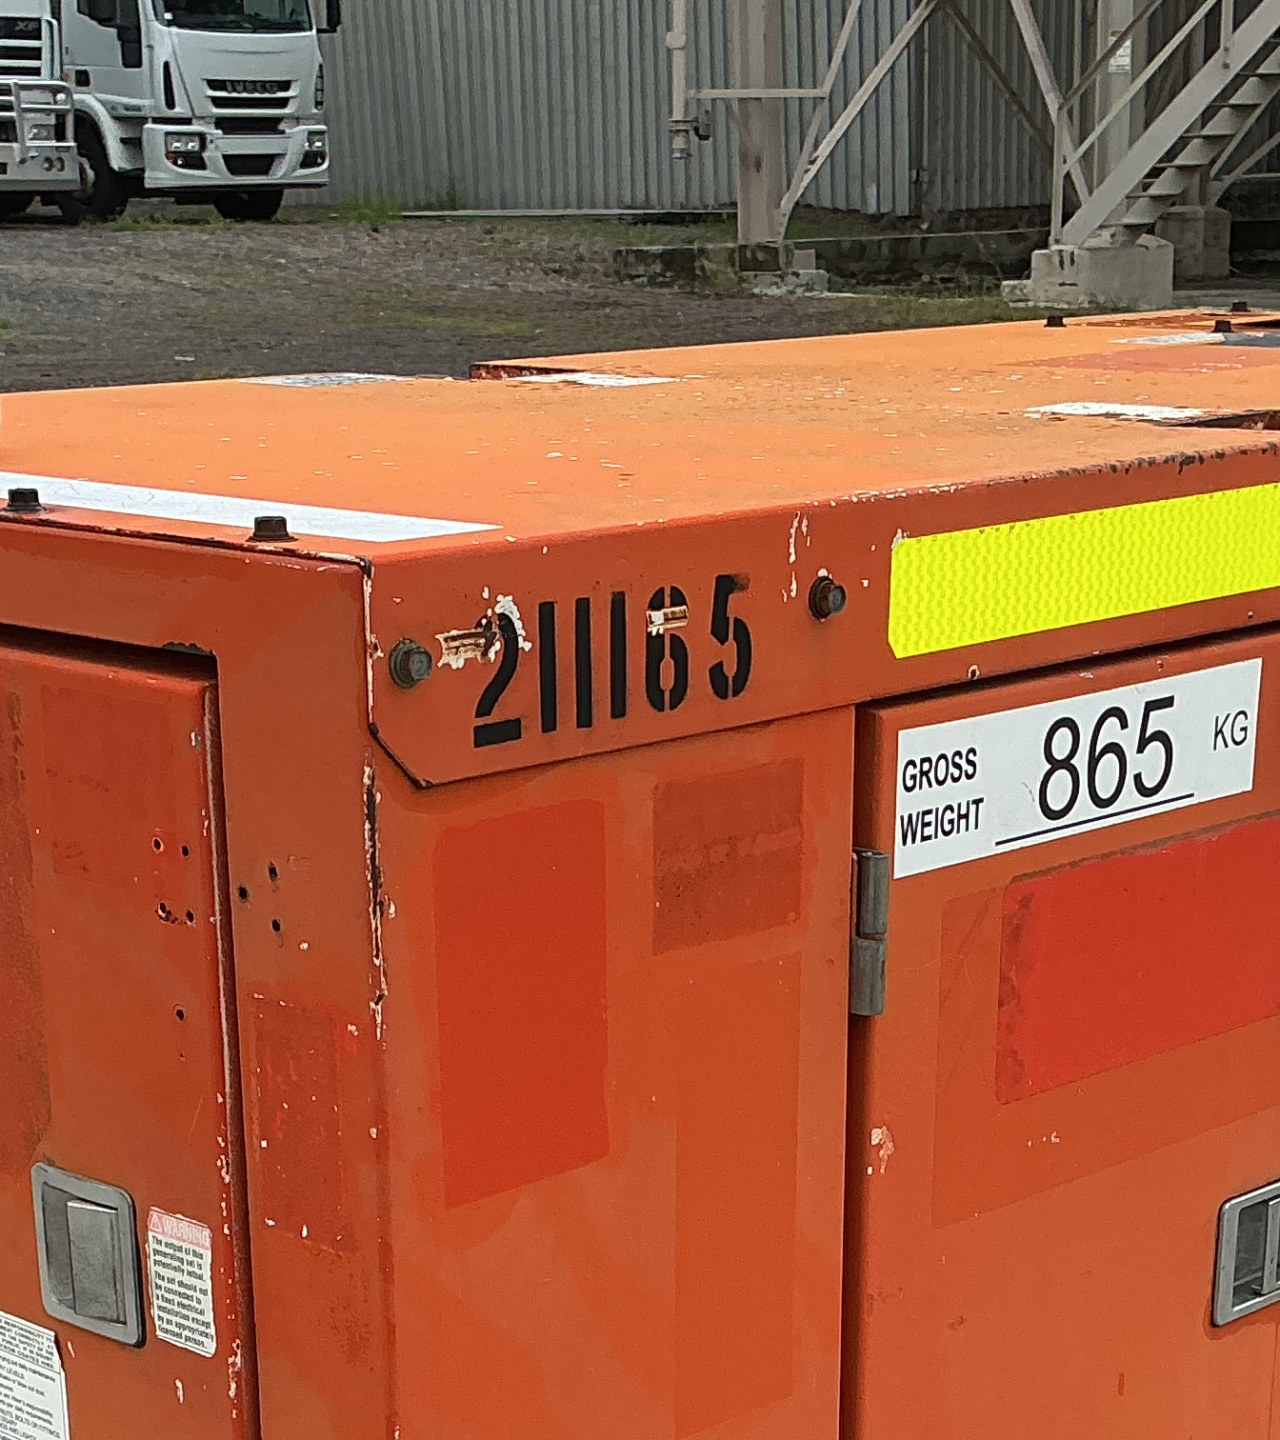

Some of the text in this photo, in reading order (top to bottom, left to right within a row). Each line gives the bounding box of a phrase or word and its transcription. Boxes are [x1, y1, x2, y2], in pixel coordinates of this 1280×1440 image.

[225, 80, 278, 94] IVECO
[472, 573, 752, 748] 211165
[902, 746, 978, 793] GROSS
[1038, 695, 1250, 822] 865 KG
[900, 796, 985, 847] WEIGHT
[163, 1217, 210, 1245] WARNING
